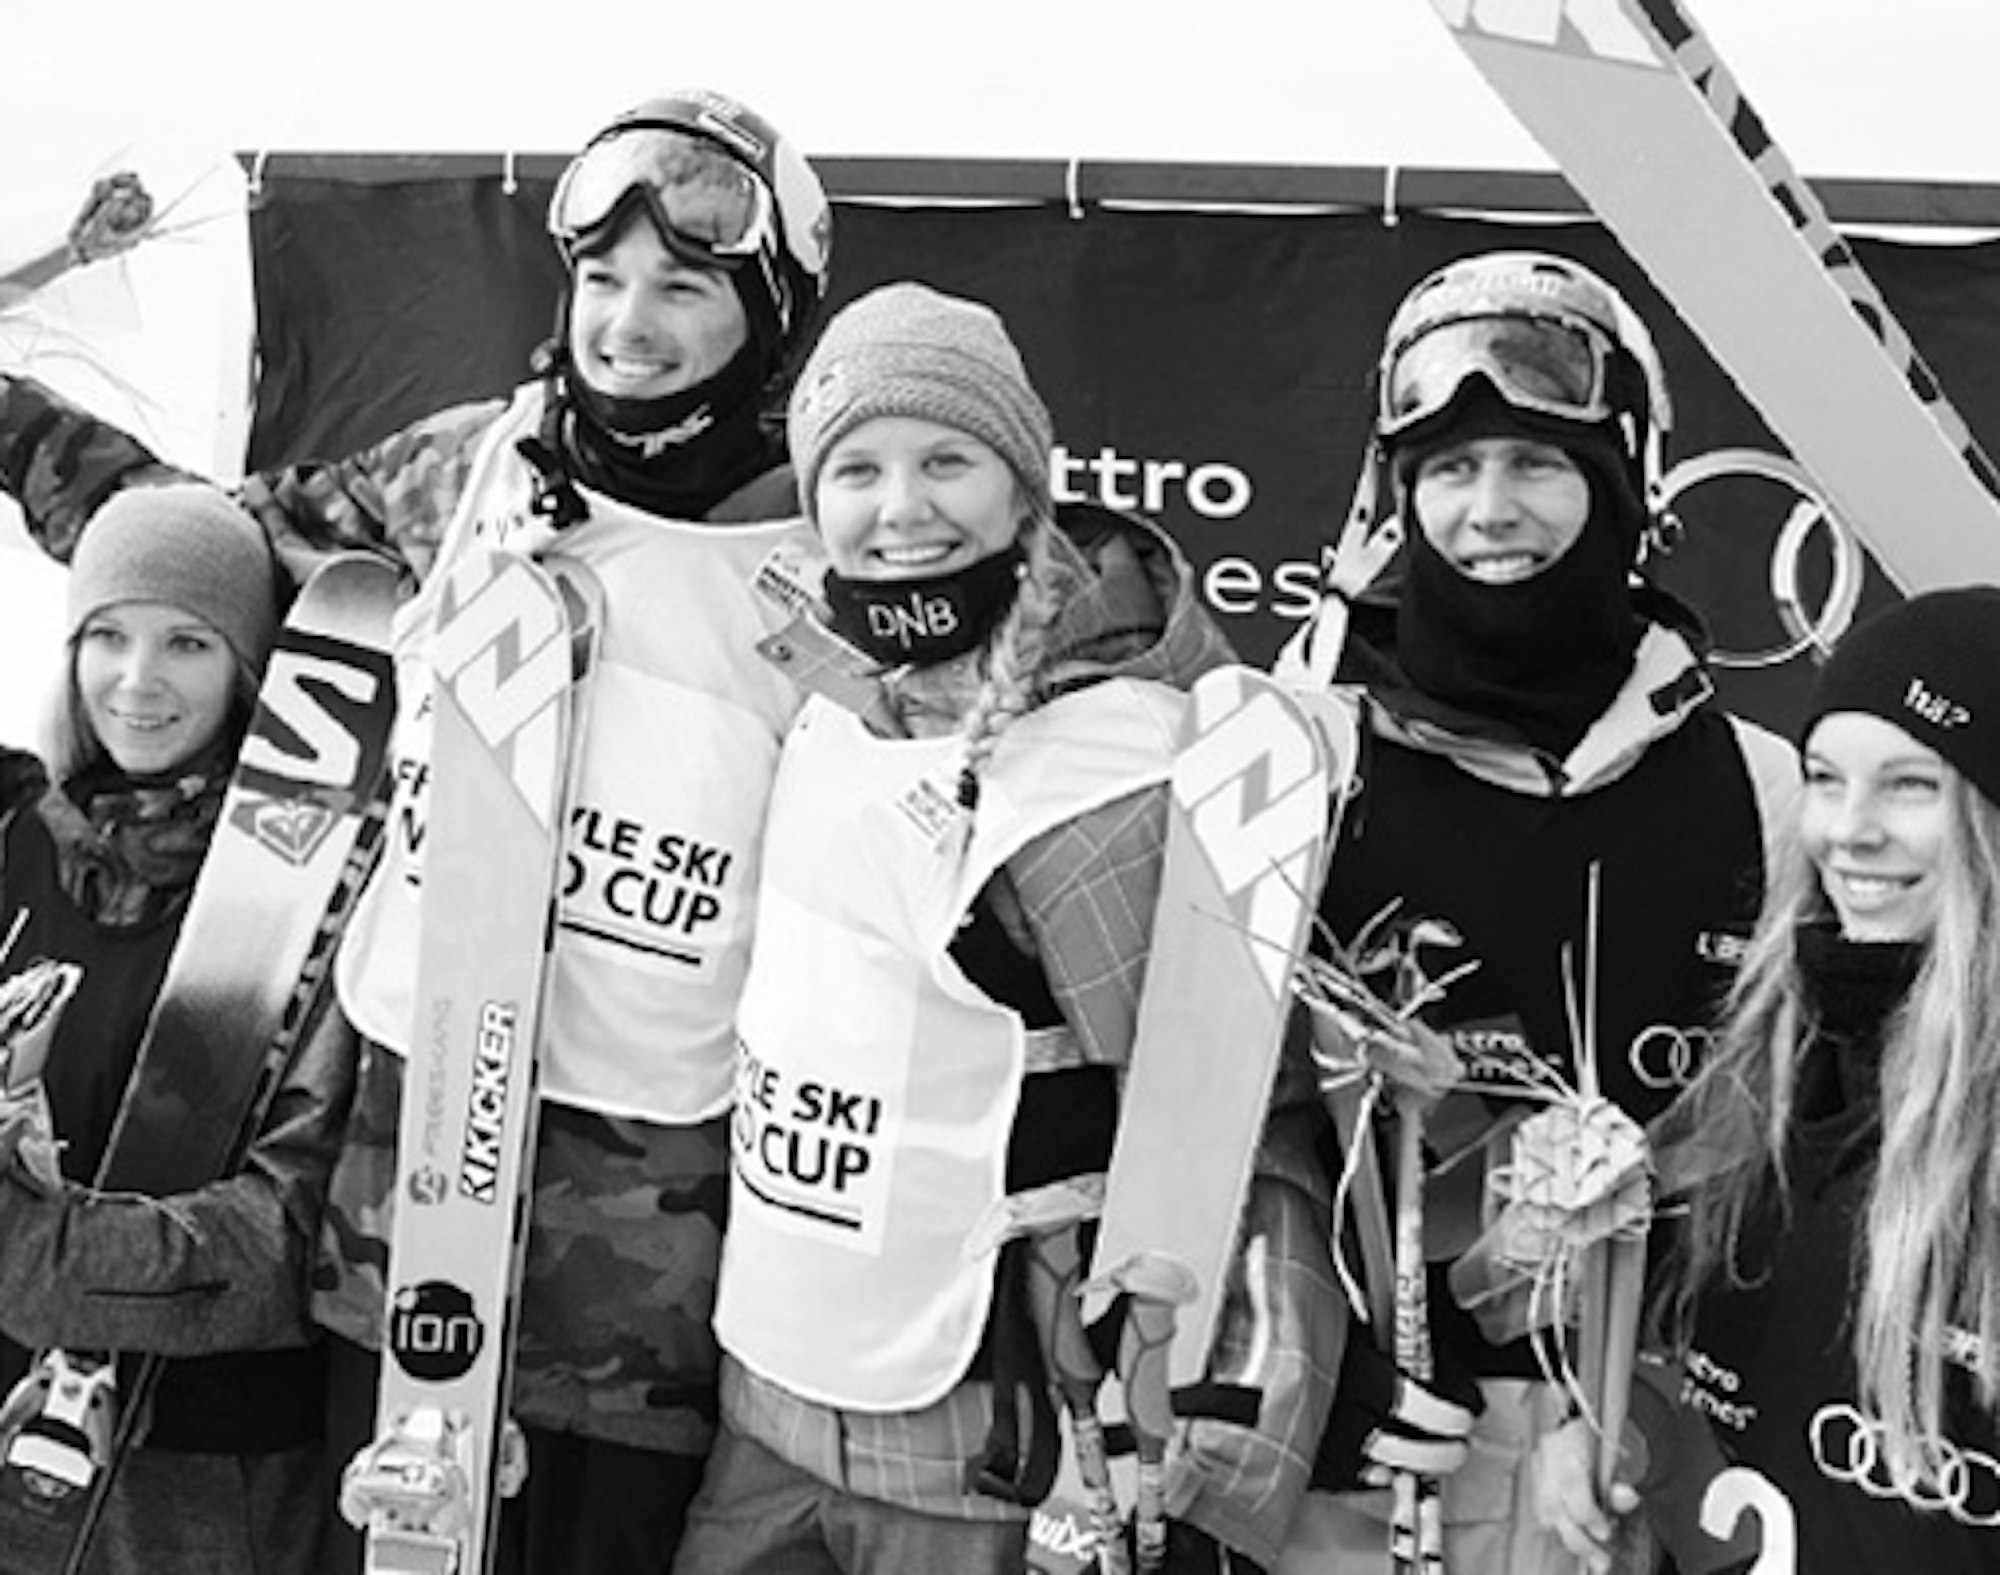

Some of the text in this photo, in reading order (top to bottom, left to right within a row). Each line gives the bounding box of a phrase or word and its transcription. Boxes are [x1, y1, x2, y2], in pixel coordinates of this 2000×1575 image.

[1050, 446, 1252, 518] ttro
[868, 592, 959, 648] DNB
[571, 807, 732, 887] LE SKI
[603, 867, 719, 933] CUP
[792, 1082, 882, 1134] SKI
[760, 1123, 870, 1193] CUP
[397, 1291, 477, 1354] ion
